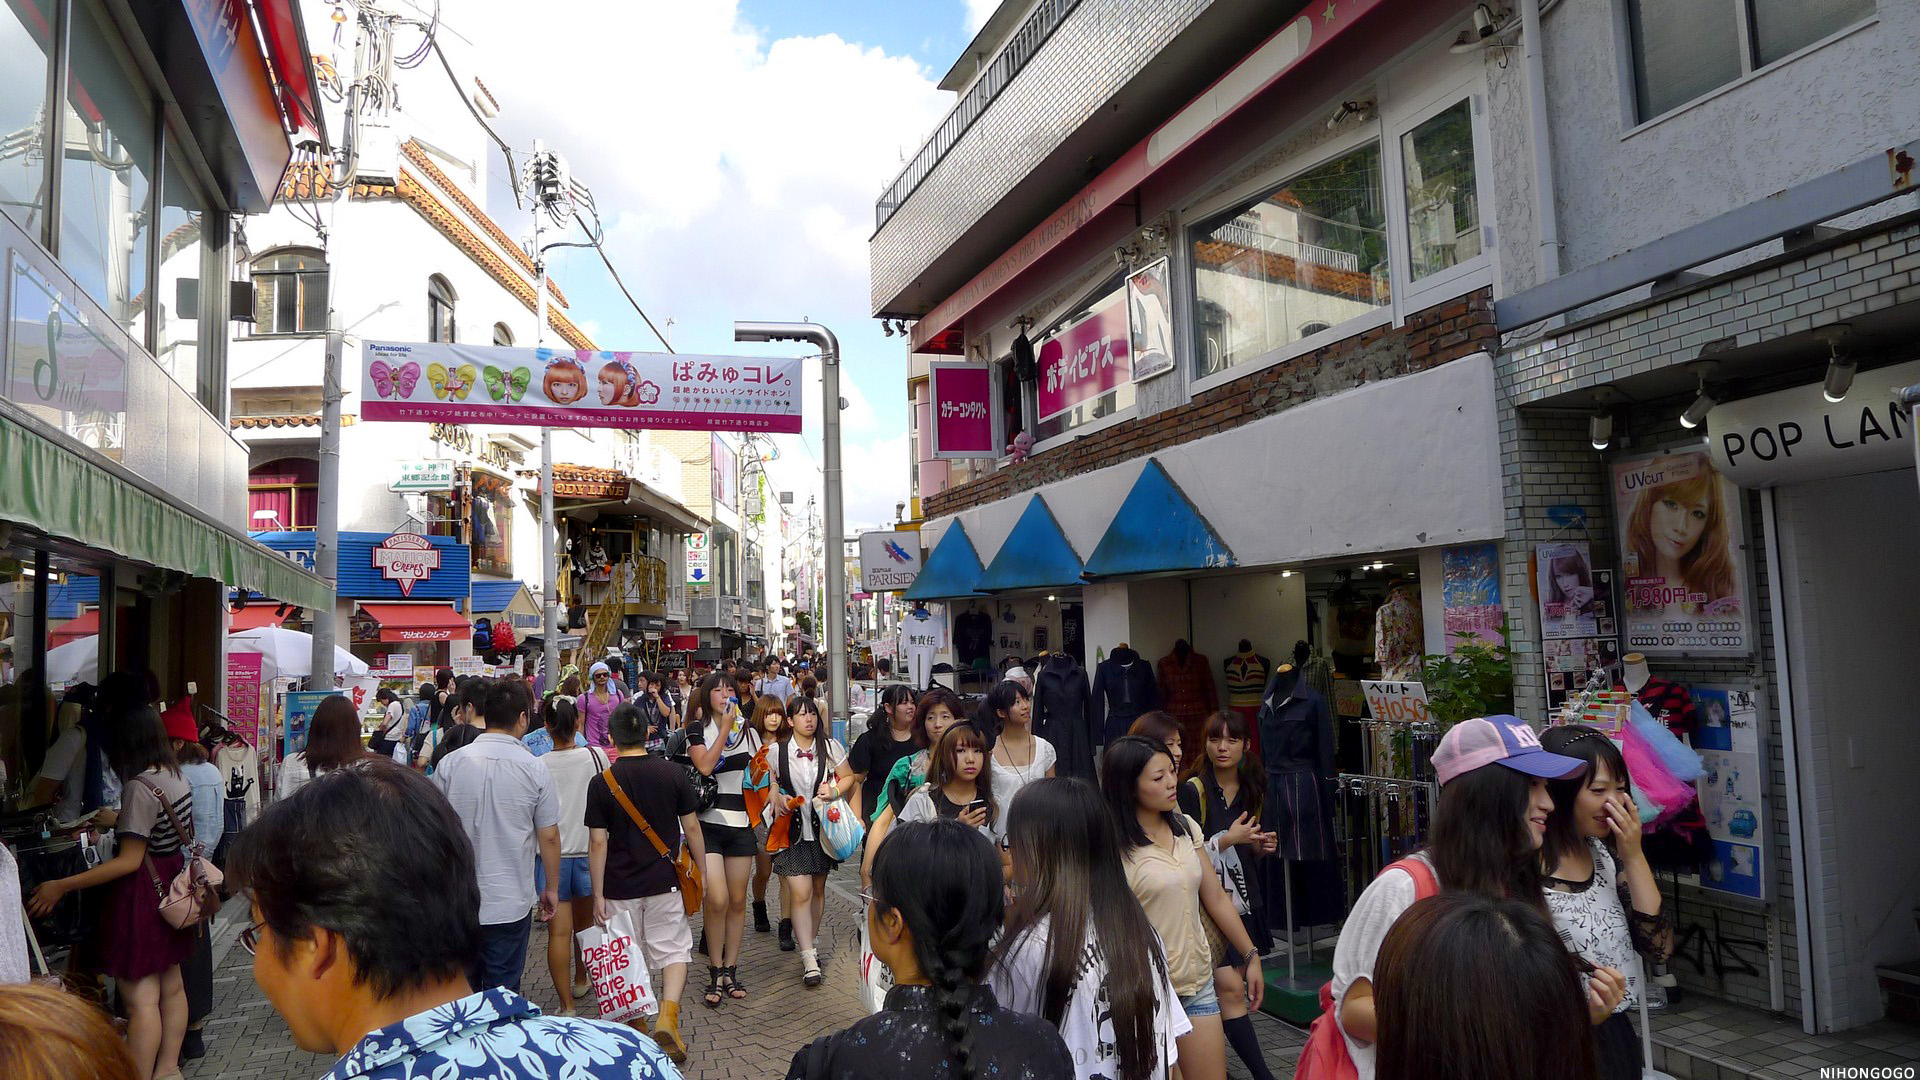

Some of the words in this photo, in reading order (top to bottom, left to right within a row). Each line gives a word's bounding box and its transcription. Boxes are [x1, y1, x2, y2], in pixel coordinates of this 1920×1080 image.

[1019, 238, 1037, 264] PRO
[1038, 188, 1097, 248] WRESTLING
[369, 344, 412, 352] Panasonic
[1046, 334, 1114, 394] ボディピアス
[672, 360, 792, 386] ぱみゅコレ。
[941, 400, 987, 419] カラーコンタクト
[1722, 421, 1803, 467] POP
[1666, 459, 1693, 472] Contact
[401, 473, 450, 482] 東郷記念館
[1671, 469, 1690, 478] Films
[552, 483, 587, 495] ODY
[587, 484, 625, 496] LINE
[388, 535, 427, 546] PATISSERIE
[380, 551, 436, 564] MARION
[1627, 587, 1687, 609] 1,980円
[400, 630, 452, 639] マリオンクレープ
[909, 634, 937, 646] 無責任
[1369, 683, 1409, 695] ベルト
[1369, 696, 1428, 721] ¥1050
[583, 935, 631, 965] Design
[592, 975, 625, 998] tore
